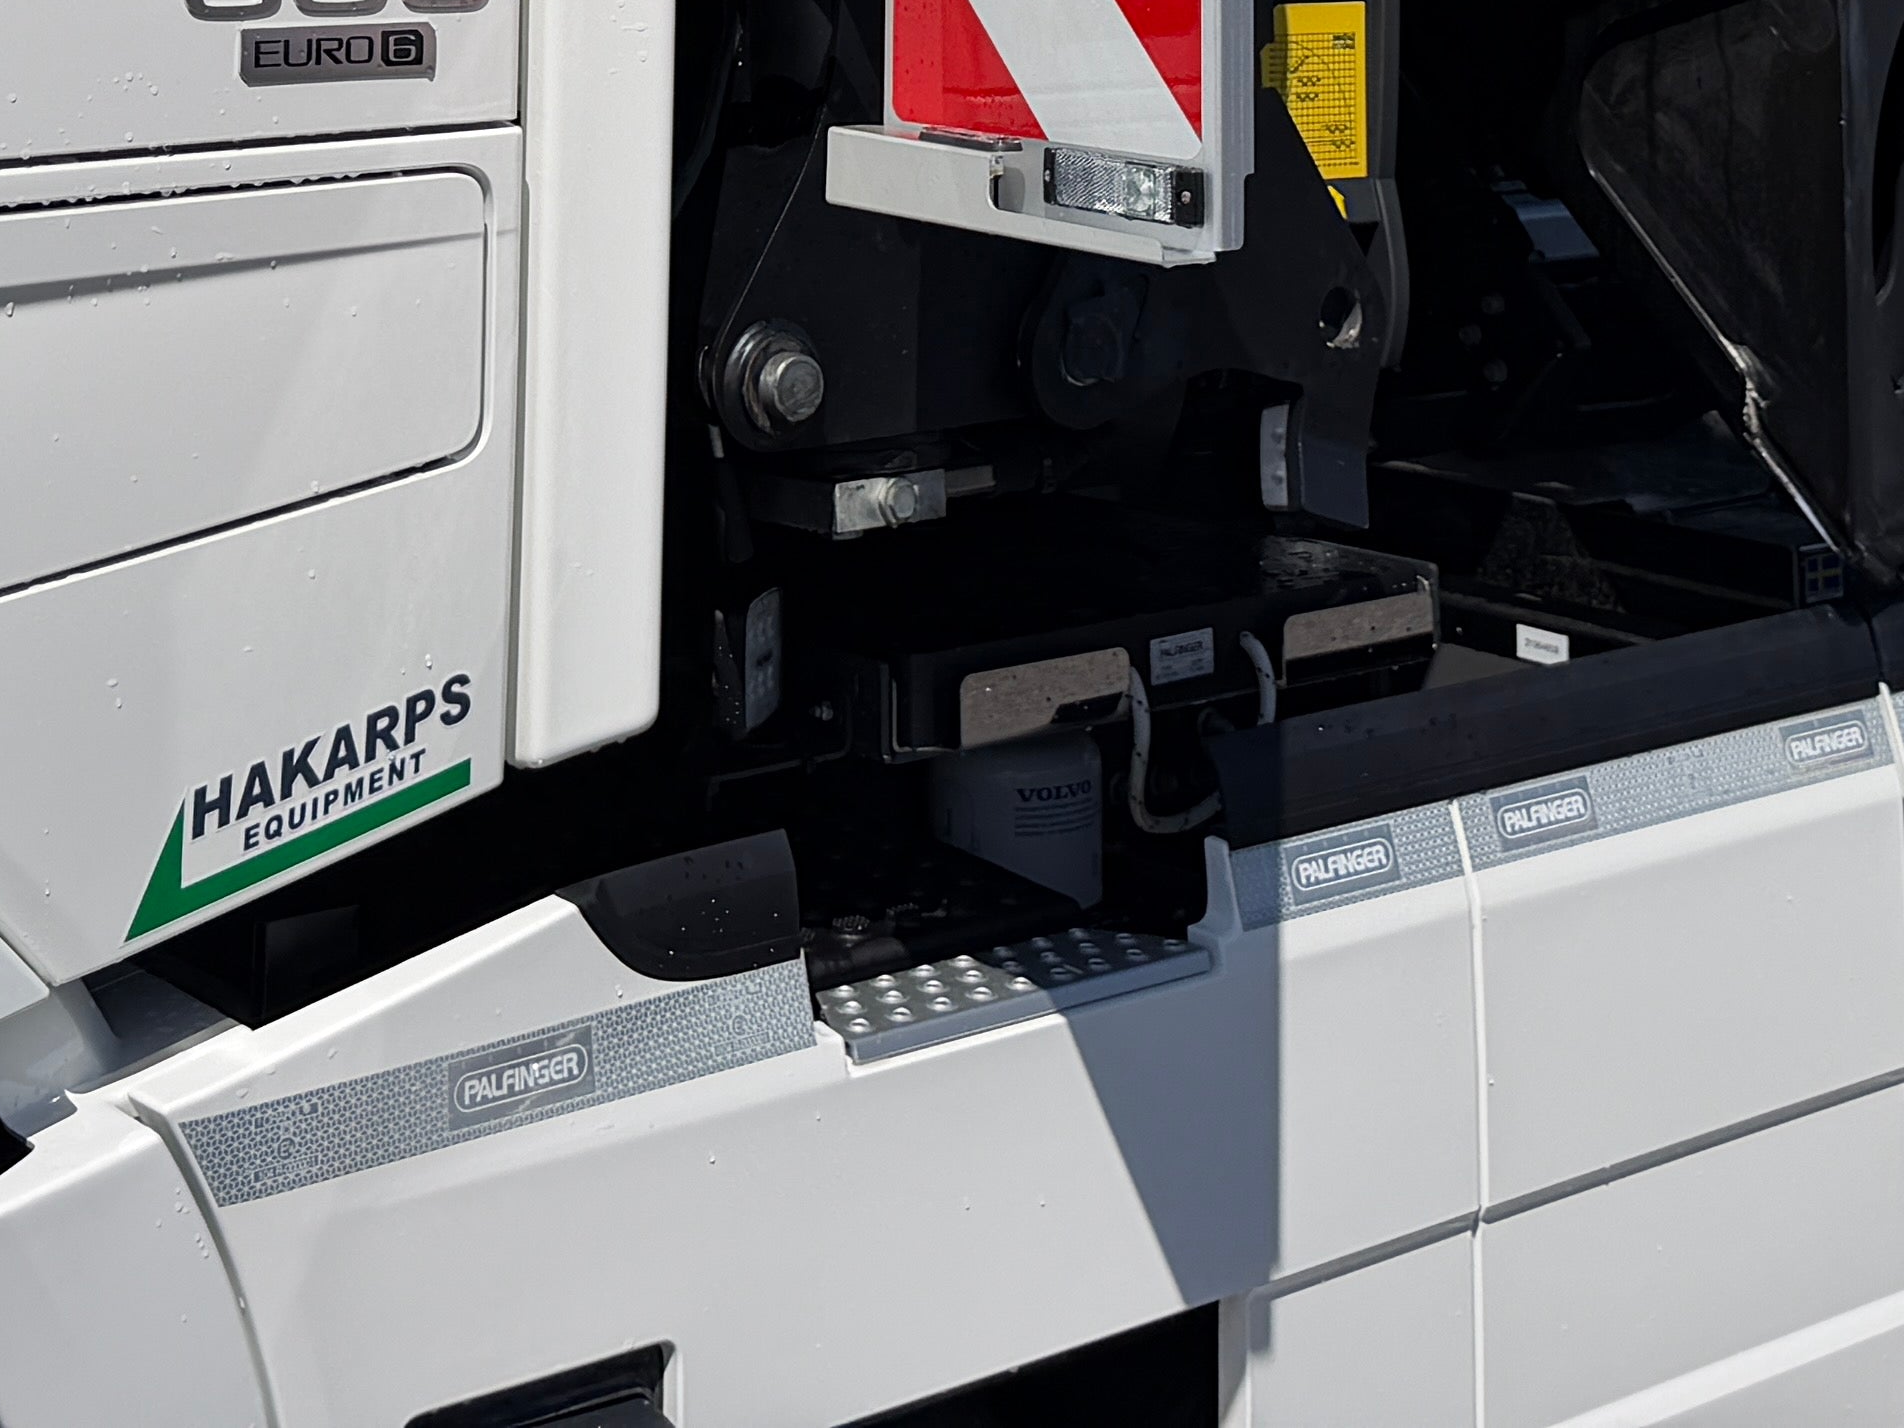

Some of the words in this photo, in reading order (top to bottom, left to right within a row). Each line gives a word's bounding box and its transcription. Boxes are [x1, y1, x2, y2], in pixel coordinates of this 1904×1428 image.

[252, 35, 375, 69] EURO
[191, 673, 472, 840] HAKARPS
[242, 747, 427, 852] EQUIPMENT
[1015, 779, 1092, 803] VOLVO
[1501, 793, 1586, 836] PALFINGER
[1297, 845, 1387, 886] PALFINGER
[463, 1052, 581, 1106] PALFINGER
